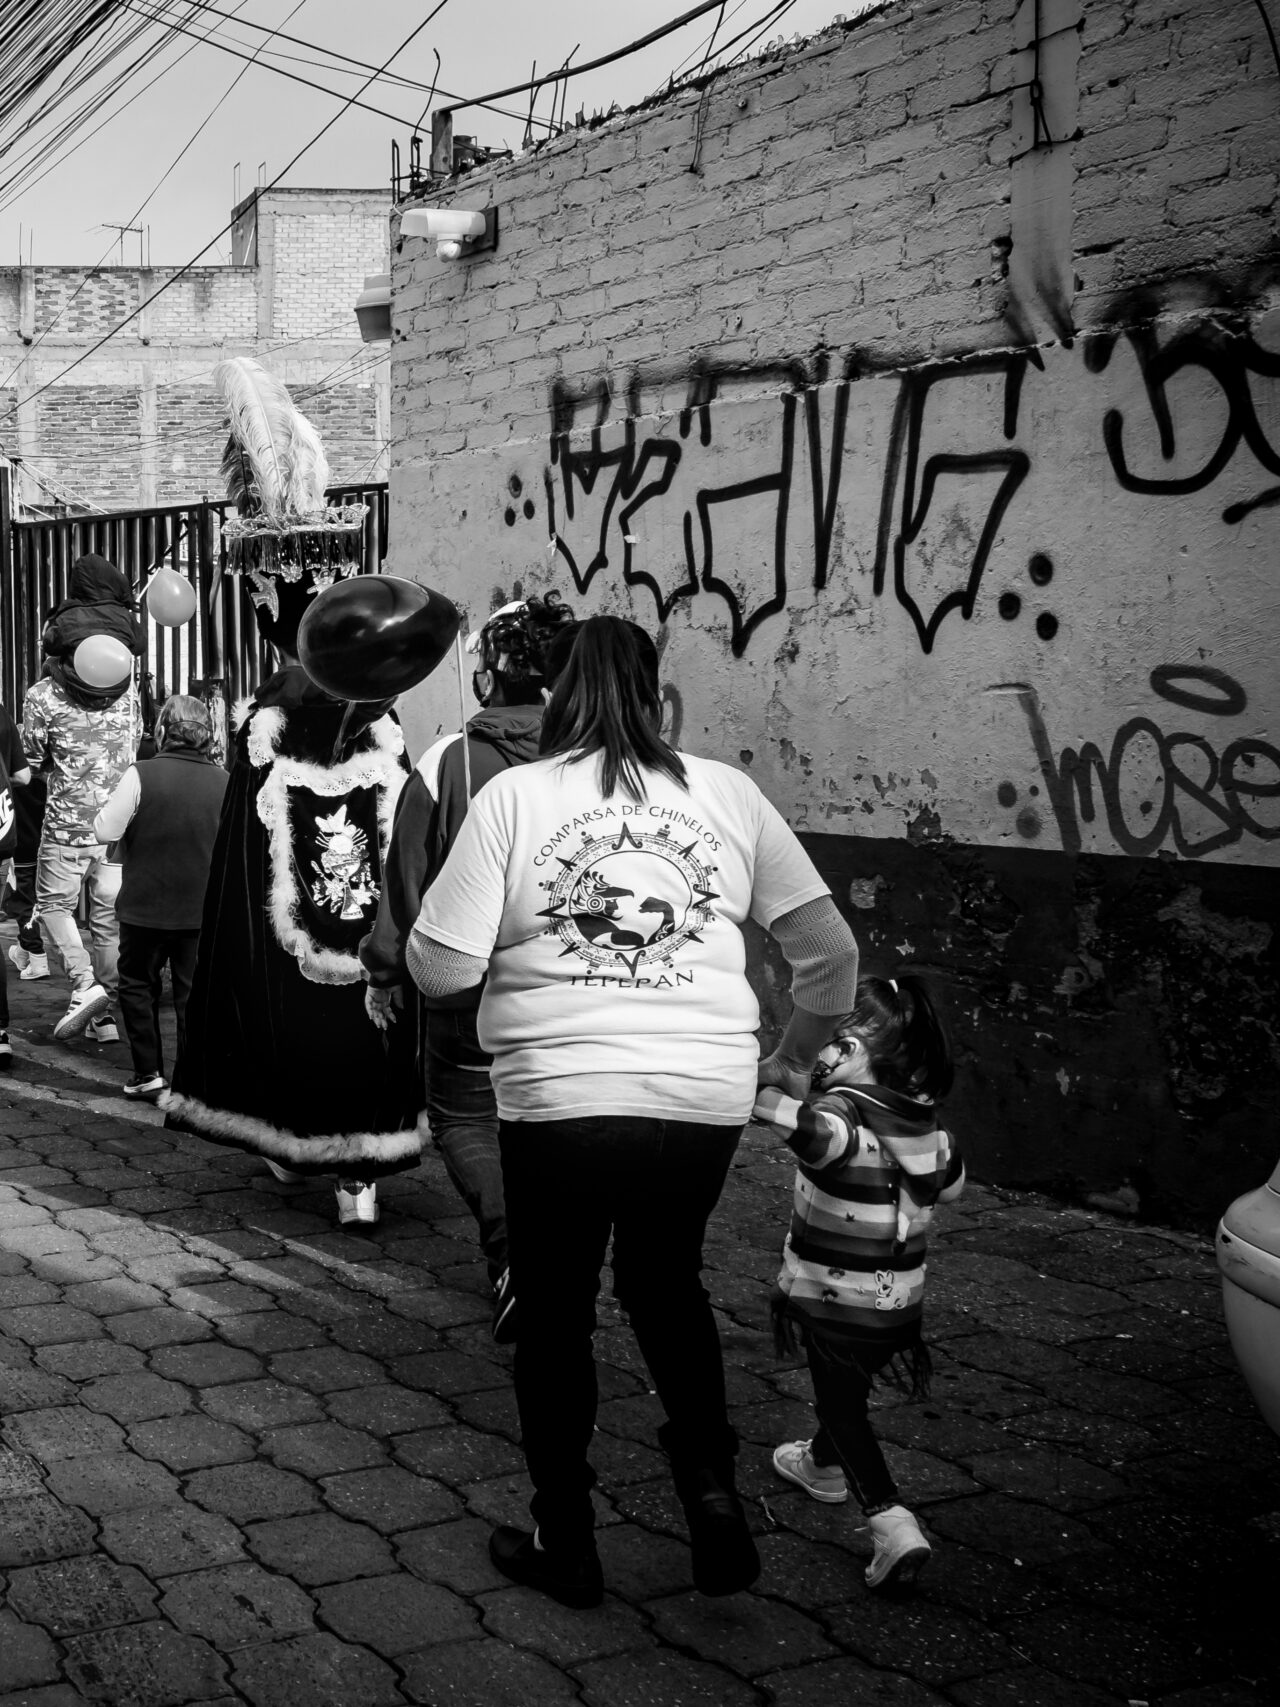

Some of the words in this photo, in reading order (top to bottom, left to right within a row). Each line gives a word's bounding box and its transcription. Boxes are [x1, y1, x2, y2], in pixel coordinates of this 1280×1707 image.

[533, 806, 616, 867] COMPARSA
[622, 804, 643, 816] DE
[649, 805, 722, 852] CHINELOS
[568, 969, 694, 989] TEPEPAN
